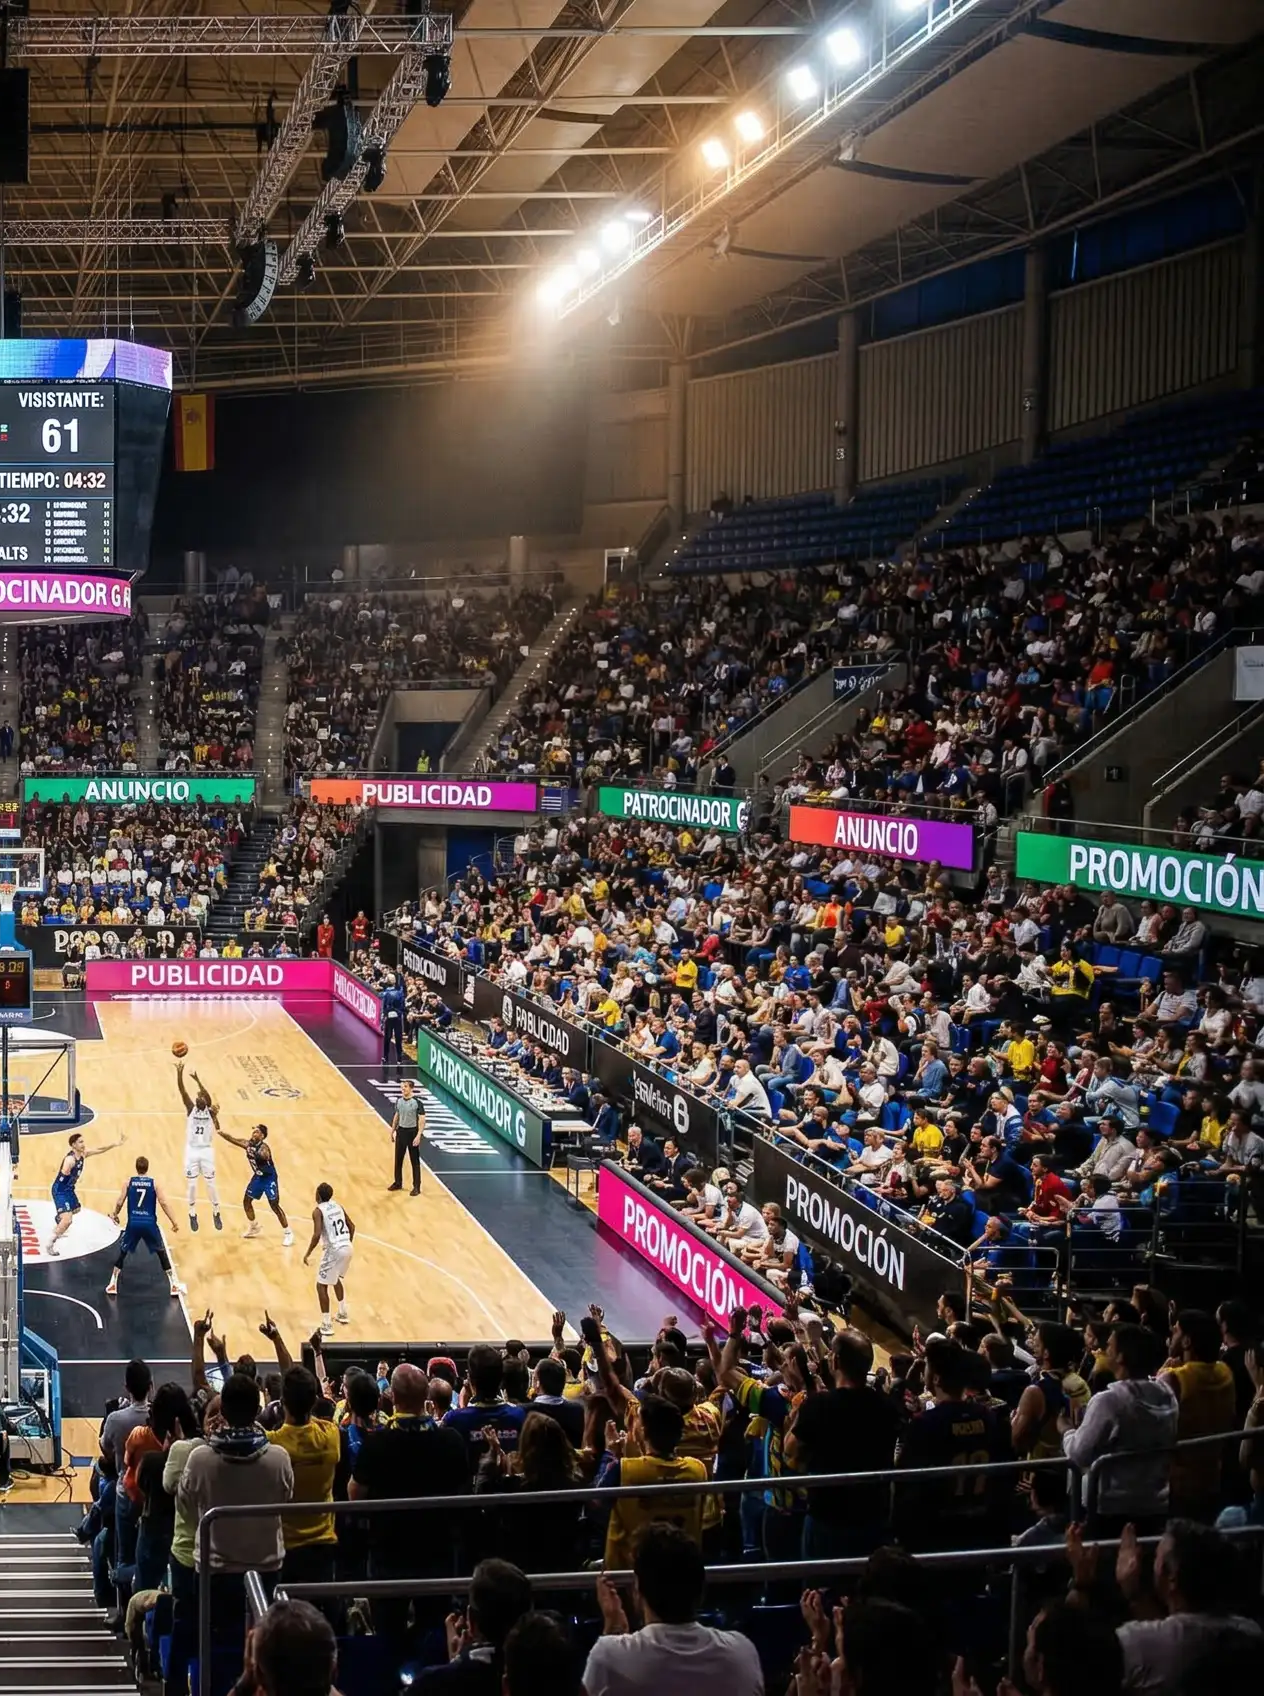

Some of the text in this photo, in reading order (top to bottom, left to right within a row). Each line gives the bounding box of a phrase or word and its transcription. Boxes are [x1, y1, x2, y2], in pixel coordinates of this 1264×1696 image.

[18, 392, 105, 408] VISISTANTE:
[42, 418, 79, 453] 61
[64, 472, 106, 489] 04:32
[84, 781, 189, 801] ANUNCIO
[361, 783, 492, 807] PUBLICIDAD
[622, 791, 732, 828] PATROCINADOR
[834, 815, 919, 856] ANUNCIO
[1069, 844, 1264, 913] PROMOCIÓN
[130, 964, 284, 986] PUBLICIDAD
[429, 1043, 512, 1135] PATROCINADOR
[515, 1110, 527, 1147] G
[136, 1188, 147, 1208] 7
[786, 1174, 905, 1291] PROMOCIÓN
[623, 1195, 745, 1316] PROMOCIÓN
